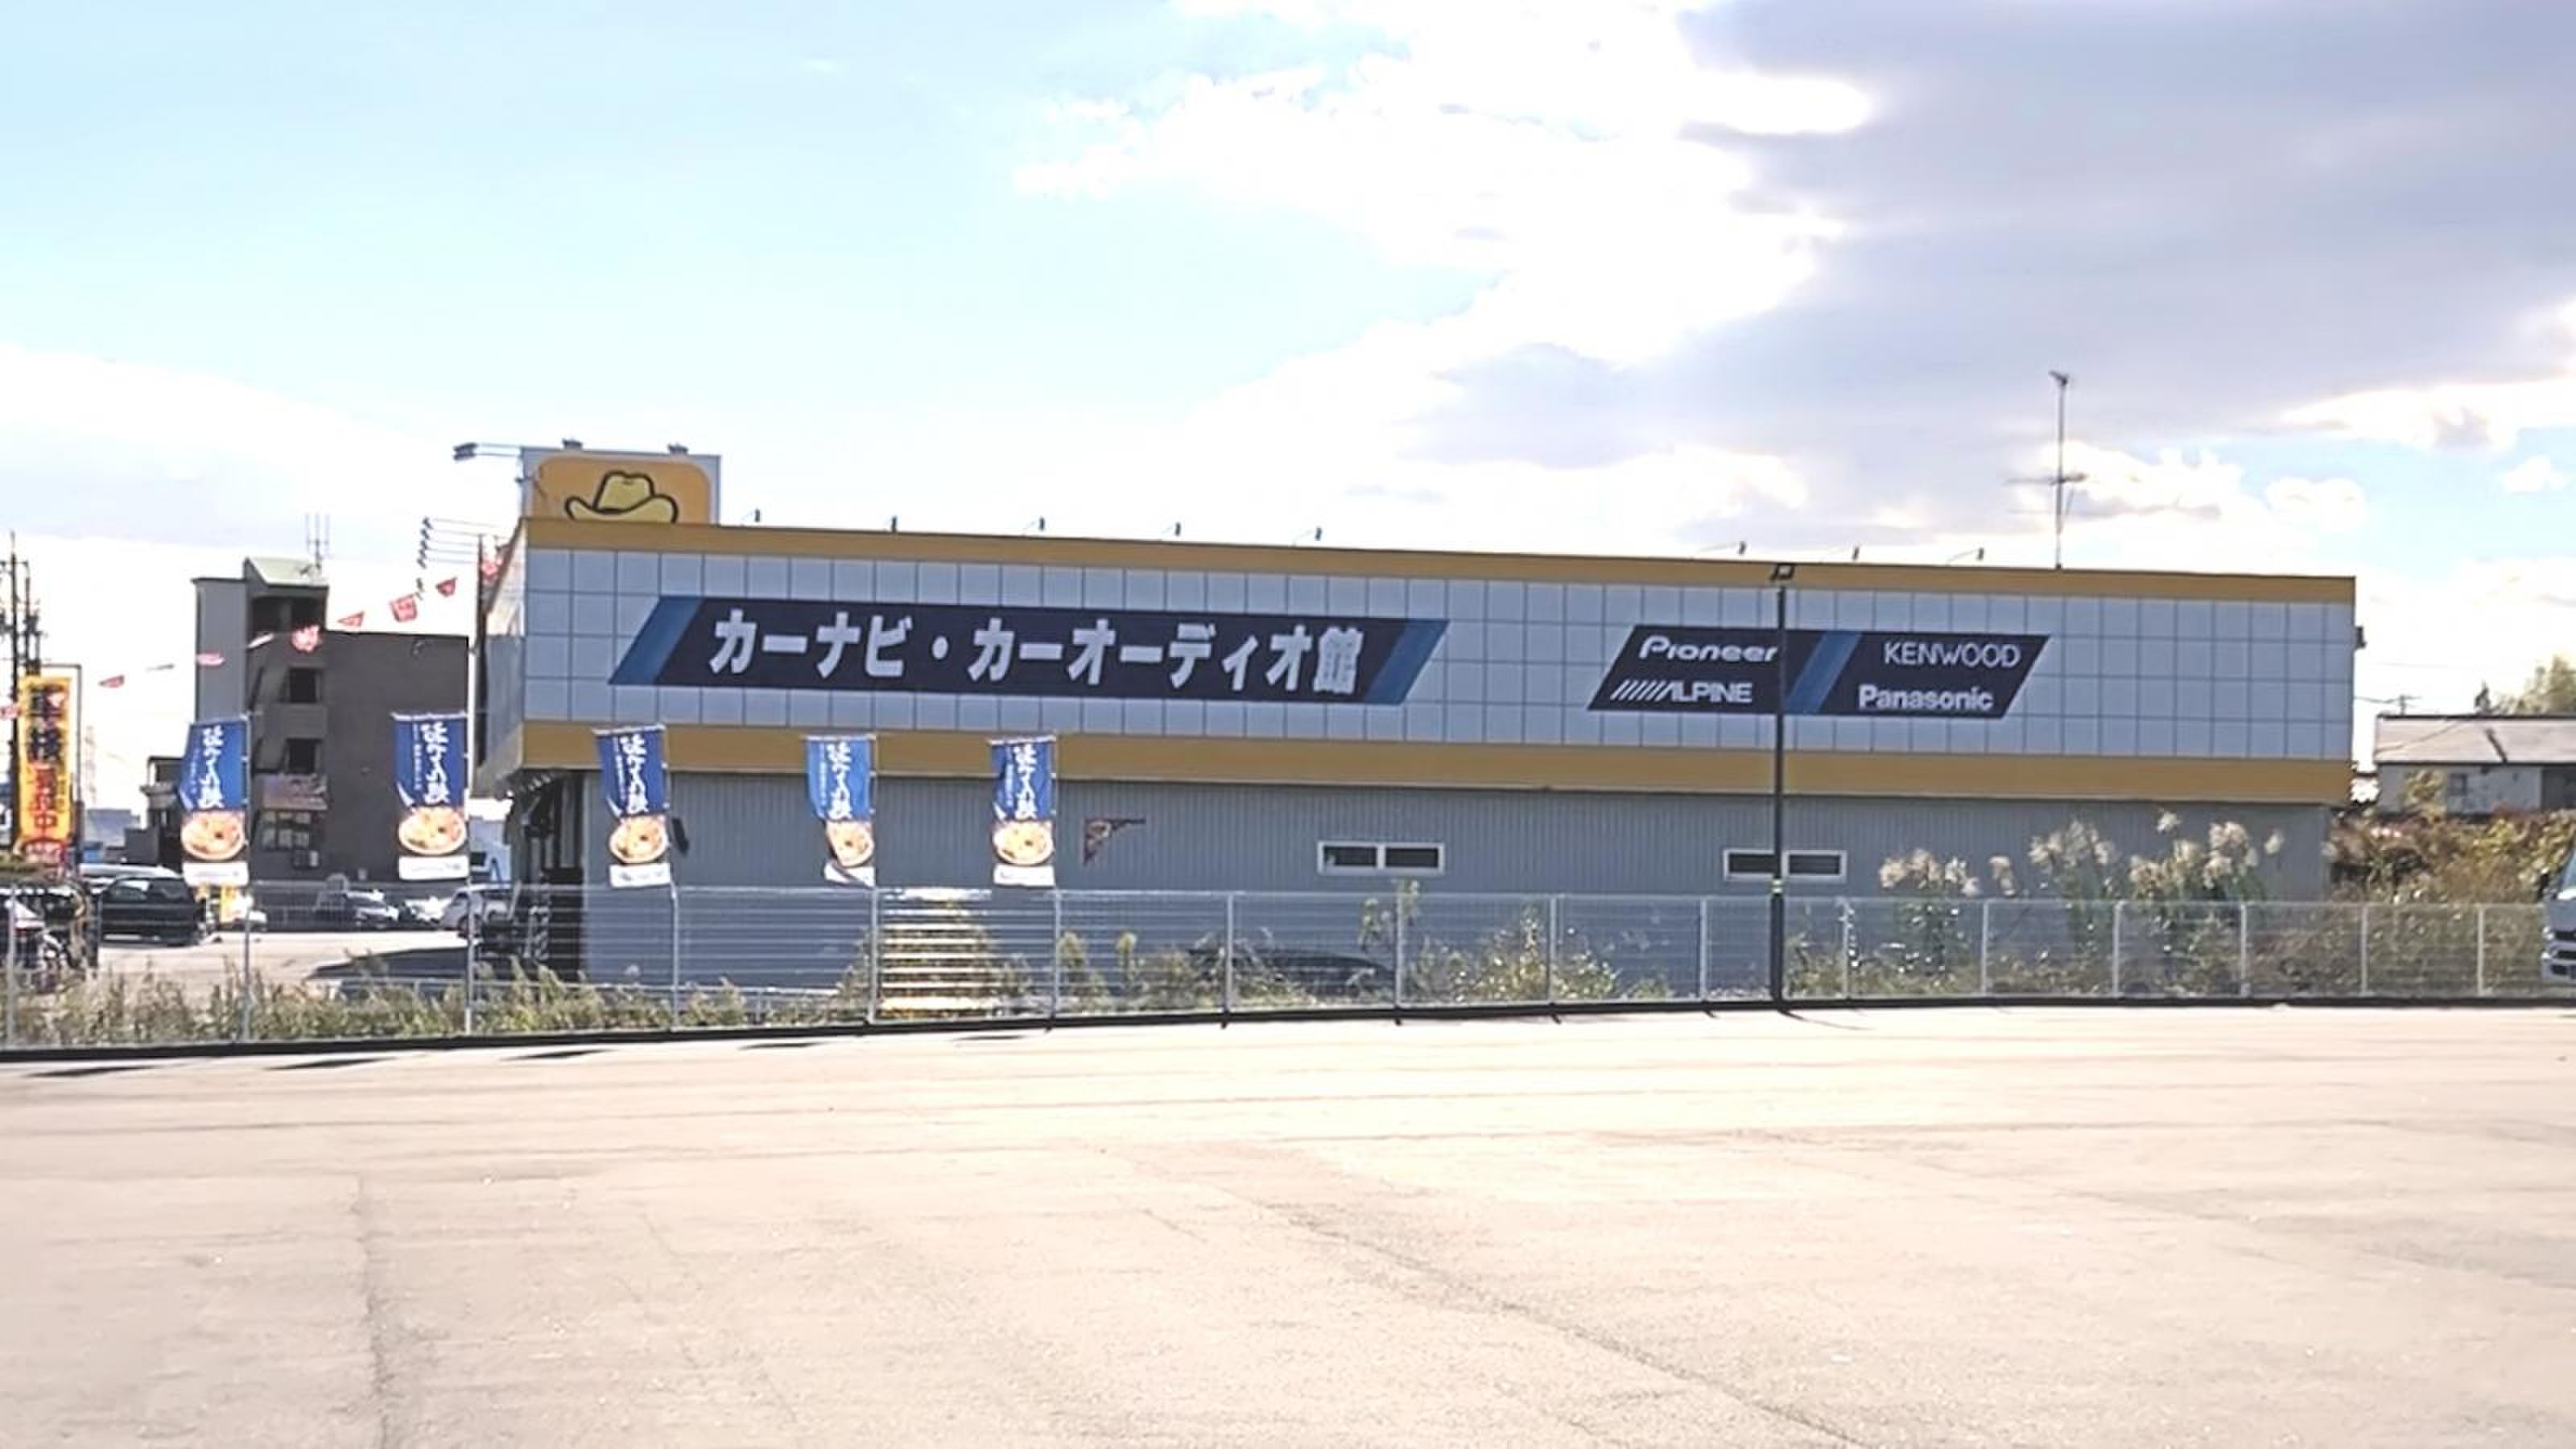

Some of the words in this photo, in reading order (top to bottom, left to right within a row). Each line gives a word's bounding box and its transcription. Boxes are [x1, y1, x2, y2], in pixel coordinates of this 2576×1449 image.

[709, 609, 1364, 696] カーナビ・カーオーディオ館
[1639, 635, 1778, 663] Pioneer
[1884, 641, 2021, 667] KENWOOD
[1653, 680, 1753, 703] ALPINE
[1858, 683, 1995, 710] Panasonic
